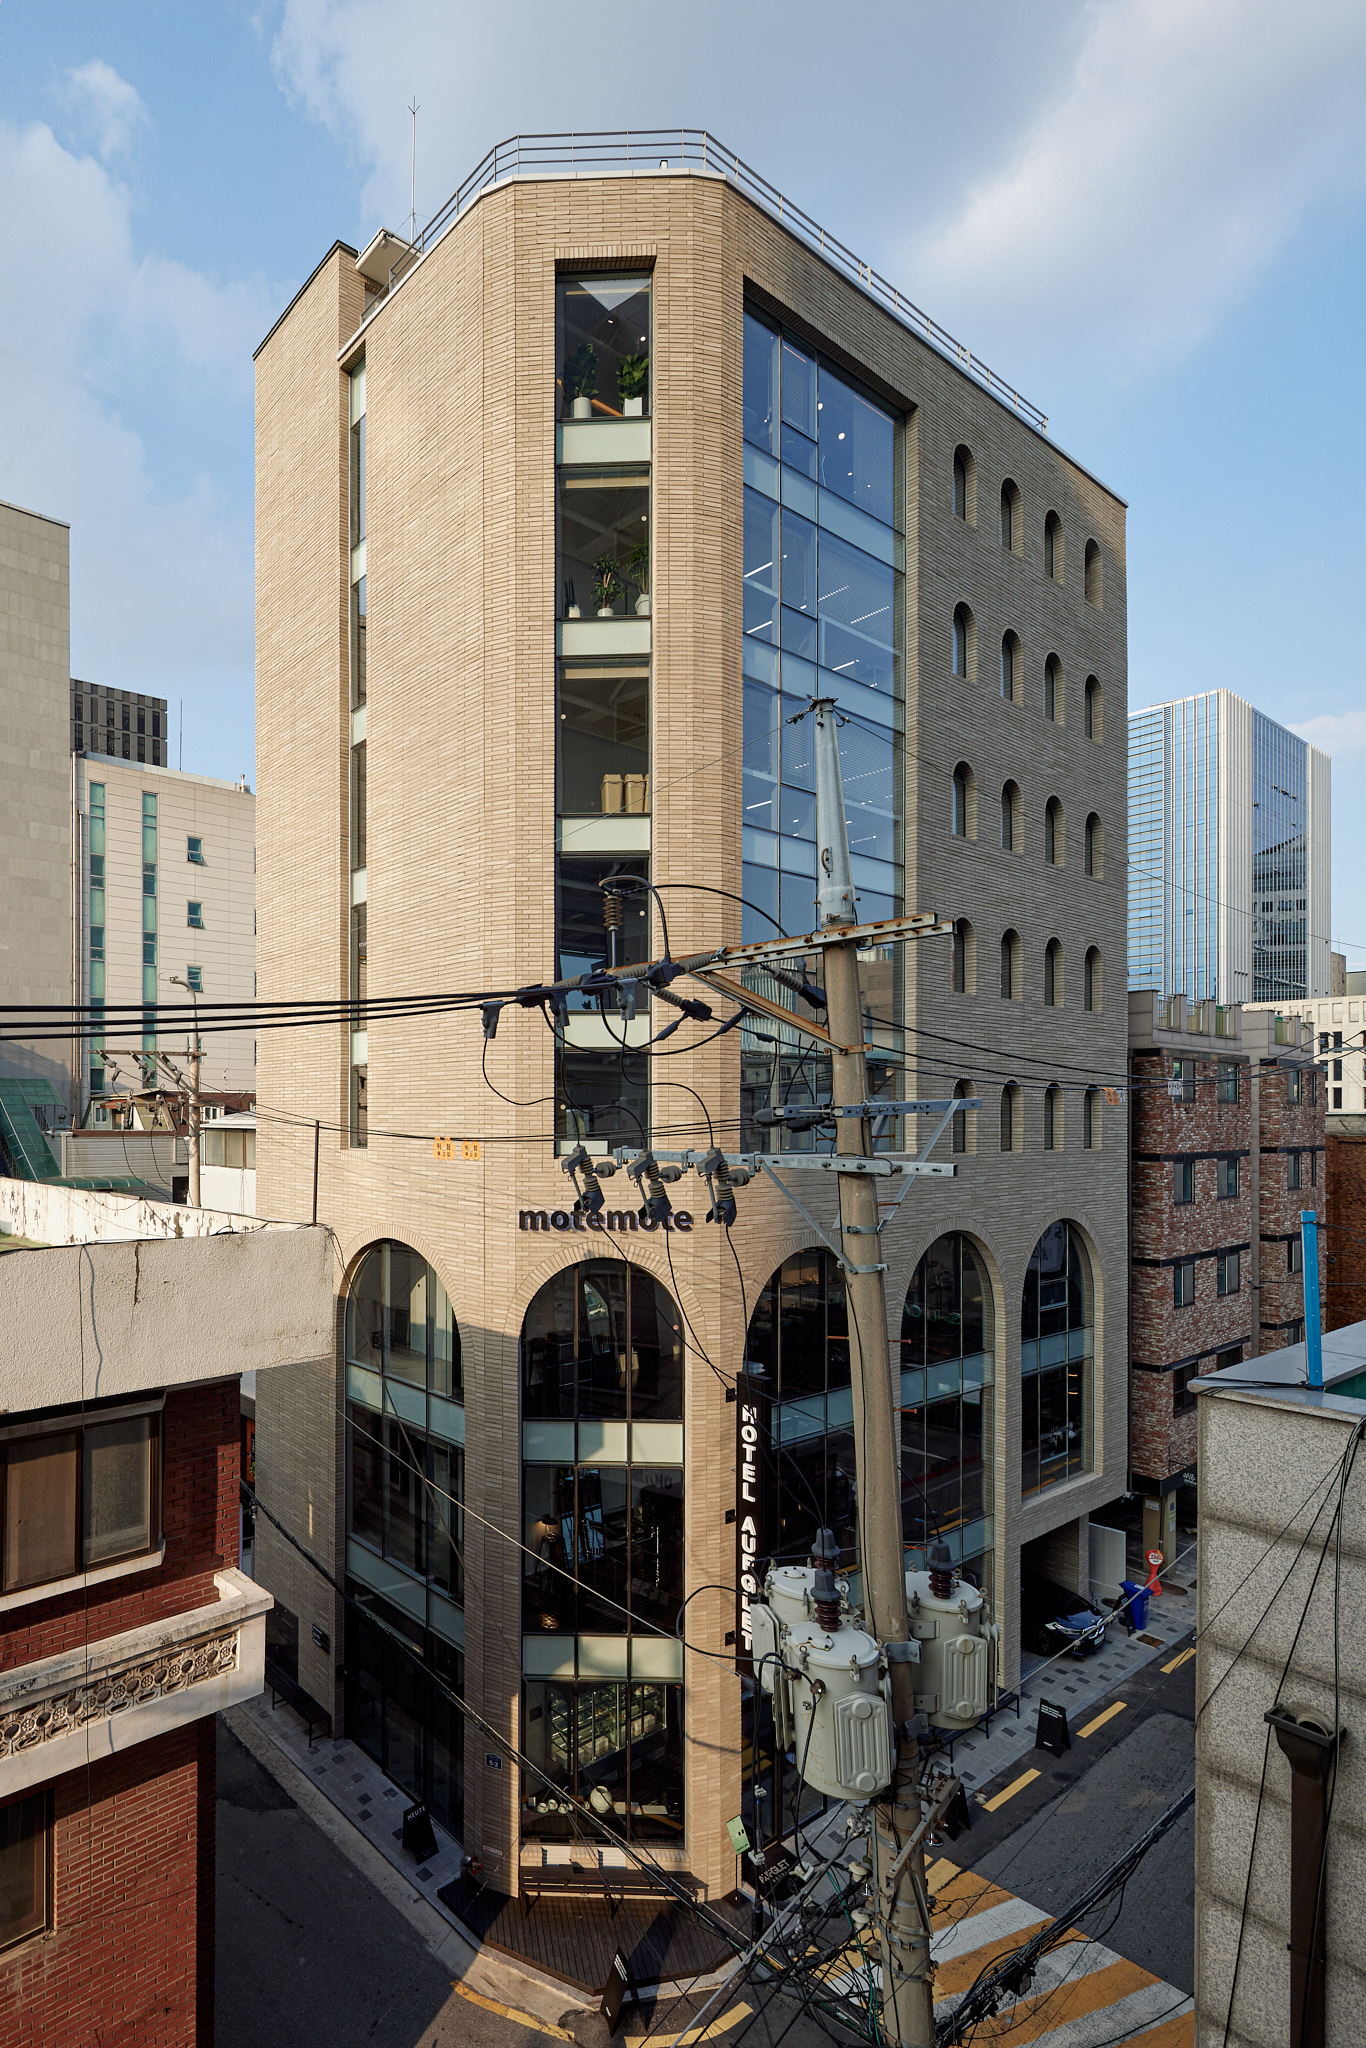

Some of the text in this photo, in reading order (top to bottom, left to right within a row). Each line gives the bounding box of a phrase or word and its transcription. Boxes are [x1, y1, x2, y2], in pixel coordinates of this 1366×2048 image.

[518, 1209, 694, 1232] motemote
[741, 1405, 757, 1651] HOTEL AUFGLET
